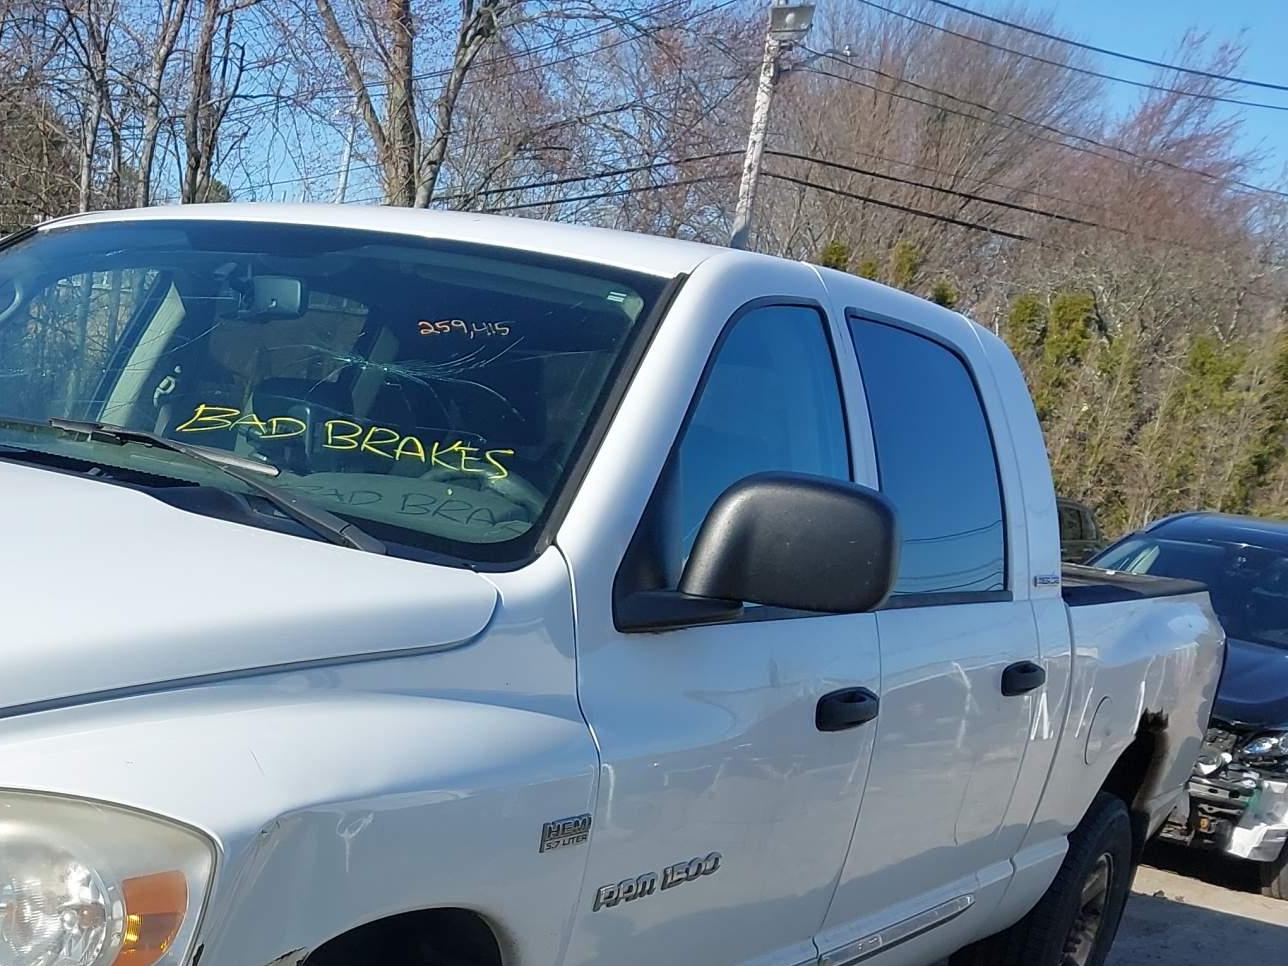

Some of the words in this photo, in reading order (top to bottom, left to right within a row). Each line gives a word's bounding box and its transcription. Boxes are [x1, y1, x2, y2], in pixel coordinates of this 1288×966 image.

[176, 403, 307, 441] BAD
[323, 419, 516, 481] BRAKES
[593, 872, 659, 912] RAM
[660, 852, 723, 890] 1500
